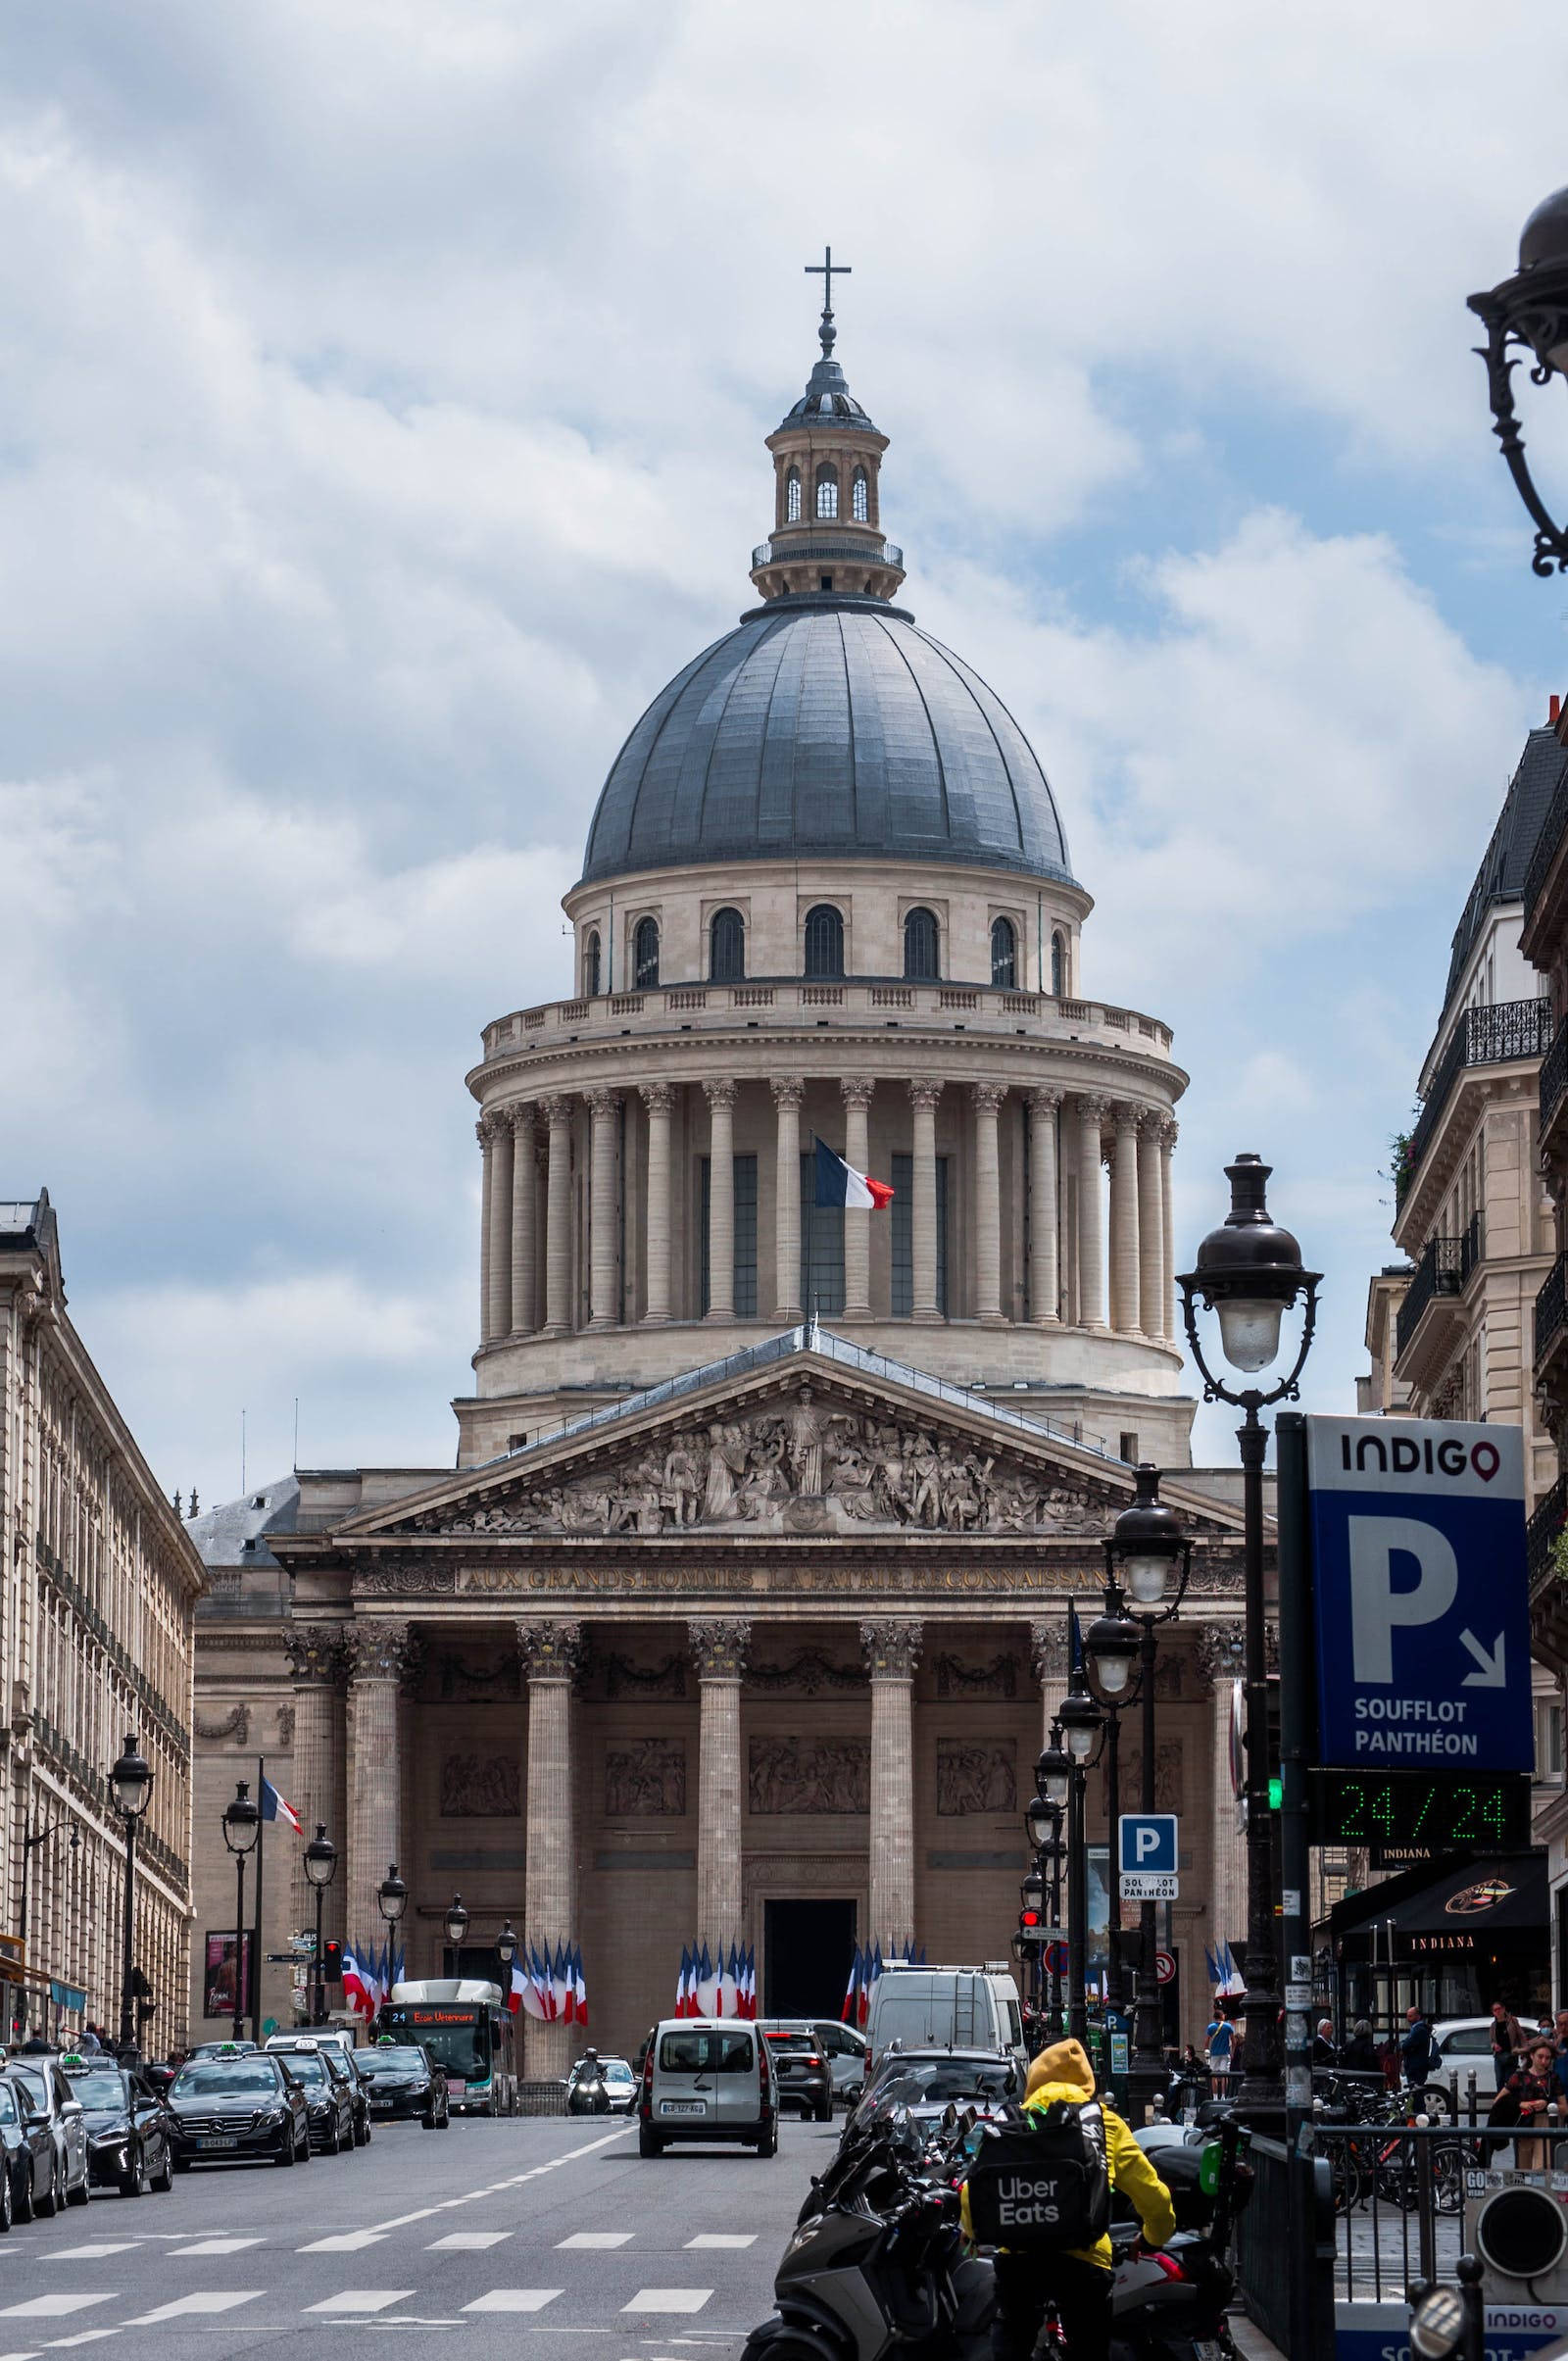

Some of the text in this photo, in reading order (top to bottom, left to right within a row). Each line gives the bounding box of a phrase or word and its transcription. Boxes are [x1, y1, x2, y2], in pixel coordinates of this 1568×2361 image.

[1342, 1435, 1500, 1482] INDIGO
[466, 1568, 521, 1588] AUX
[528, 1568, 636, 1588] GRANDS
[642, 1568, 755, 1588] HOMMES
[811, 1568, 903, 1588] PATRIE
[1348, 1515, 1458, 1683] P
[1354, 1697, 1467, 1722] SOUFFLOT
[1355, 1729, 1478, 1755] PANTHÉON
[1342, 1786, 1396, 1837] 24
[1452, 1789, 1506, 1839] 24
[1137, 1827, 1160, 1862] P
[1384, 1847, 1431, 1859] INDIANA
[1411, 1936, 1475, 1950] INDIANA
[392, 2011, 406, 2023] 24
[998, 2177, 1058, 2200] Uber
[1467, 2171, 1485, 2189] GO
[999, 2201, 1060, 2226] Eats
[1488, 2313, 1557, 2330] INDIGO
